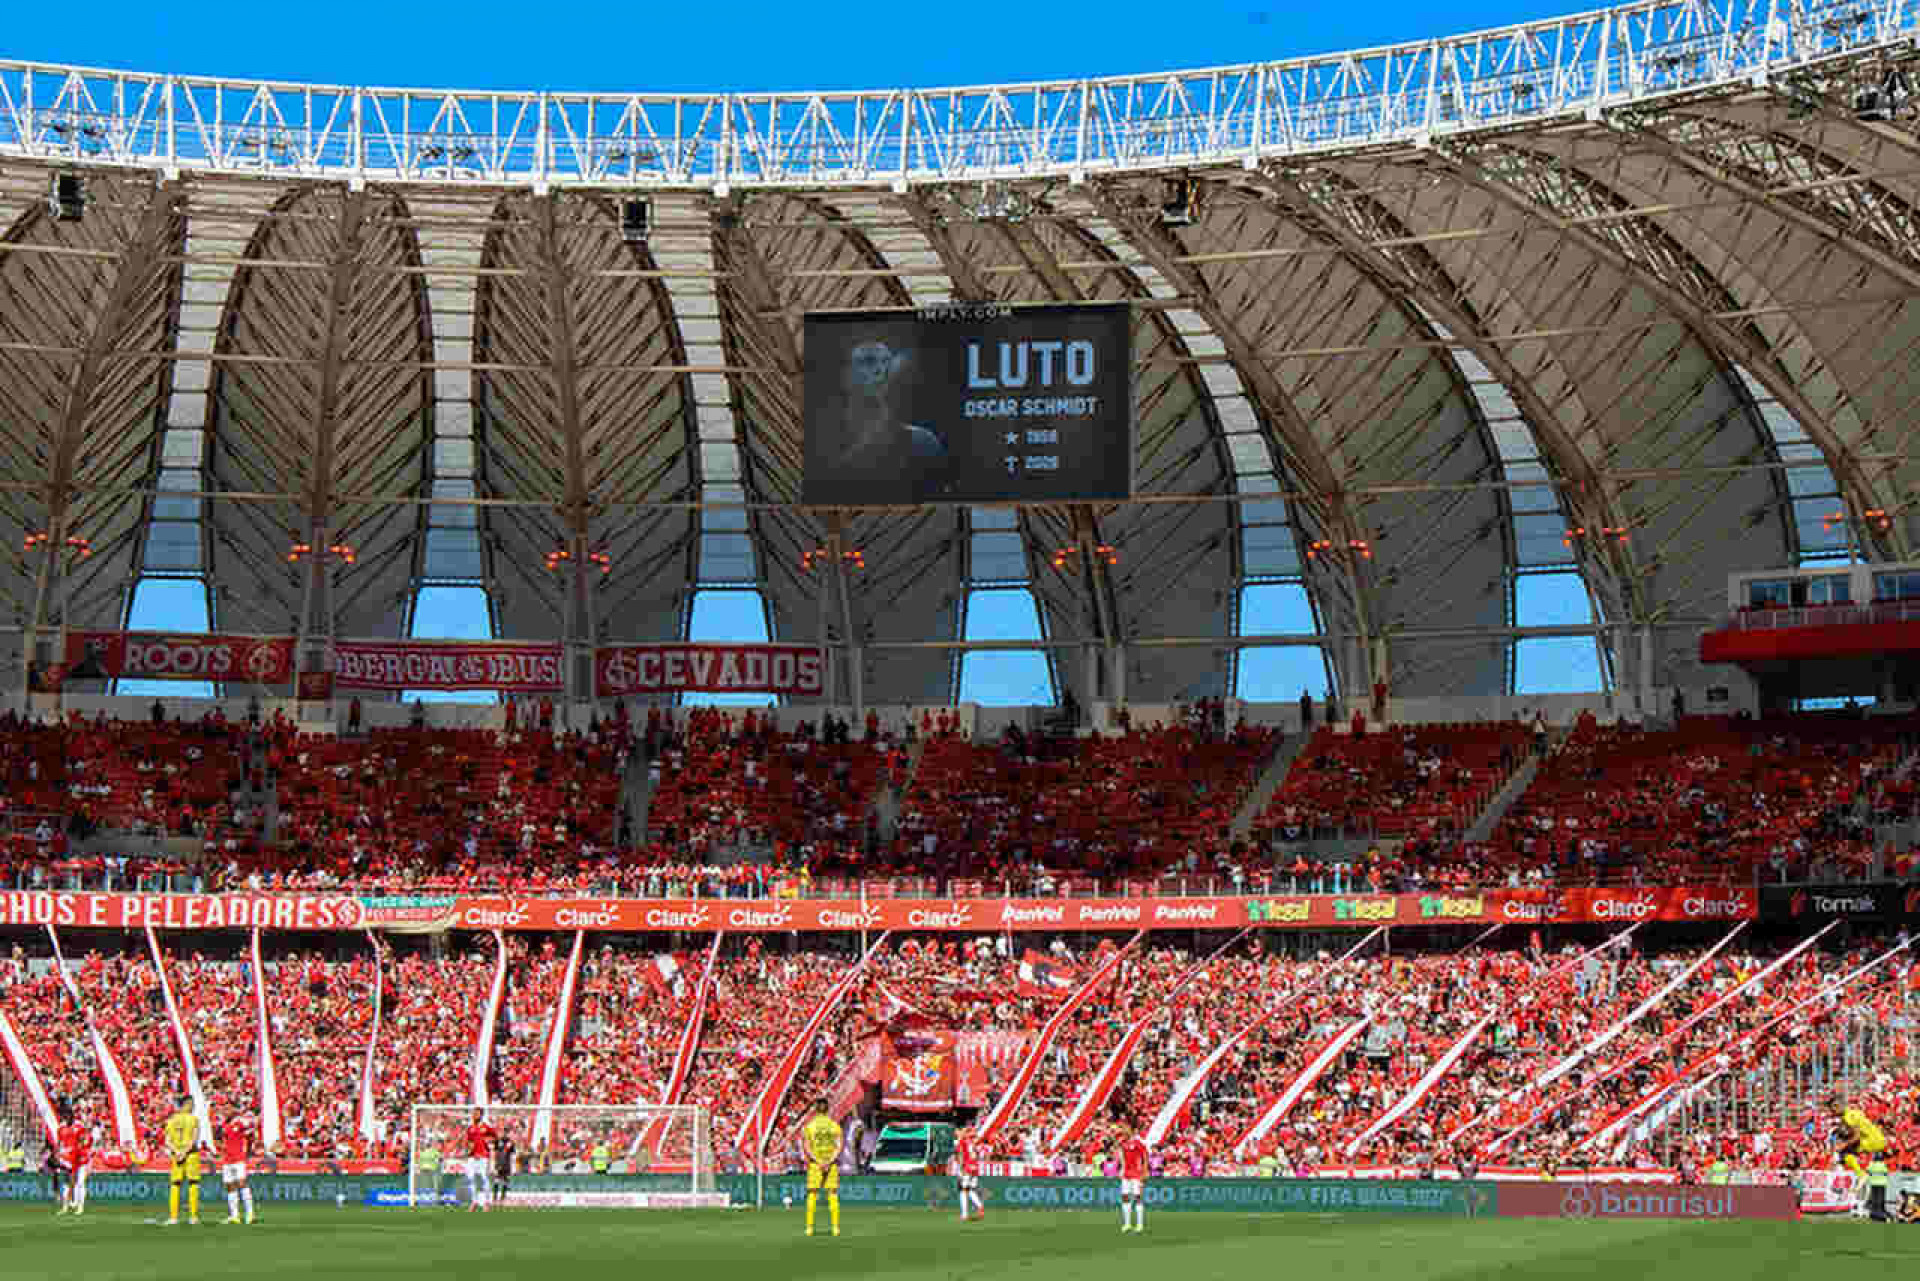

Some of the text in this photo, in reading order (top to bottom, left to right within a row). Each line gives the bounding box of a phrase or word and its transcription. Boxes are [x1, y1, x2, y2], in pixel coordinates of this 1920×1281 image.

[967, 340, 1094, 389] LUTO
[964, 396, 1098, 416] OSCAR SCHMIDT
[125, 643, 232, 673] ROOTS
[638, 651, 820, 687] CEVADOS
[90, 895, 109, 925] E
[121, 895, 341, 928] PELEADORES
[464, 907, 519, 925] Claro
[729, 907, 784, 925] Claro
[1502, 900, 1558, 918] Claro
[1593, 899, 1646, 917] Claro
[1683, 898, 1738, 916] Claro
[555, 908, 612, 926] Claro
[647, 908, 701, 926] Claro
[817, 910, 875, 927] Claro
[908, 908, 961, 928] Claro
[1004, 1186, 1060, 1203] COPA
[1064, 1186, 1094, 1203] DO
[1099, 1186, 1175, 1203] MDO
[1311, 1186, 1354, 1204] FIFA
[1601, 1184, 1735, 1215] banrisul
